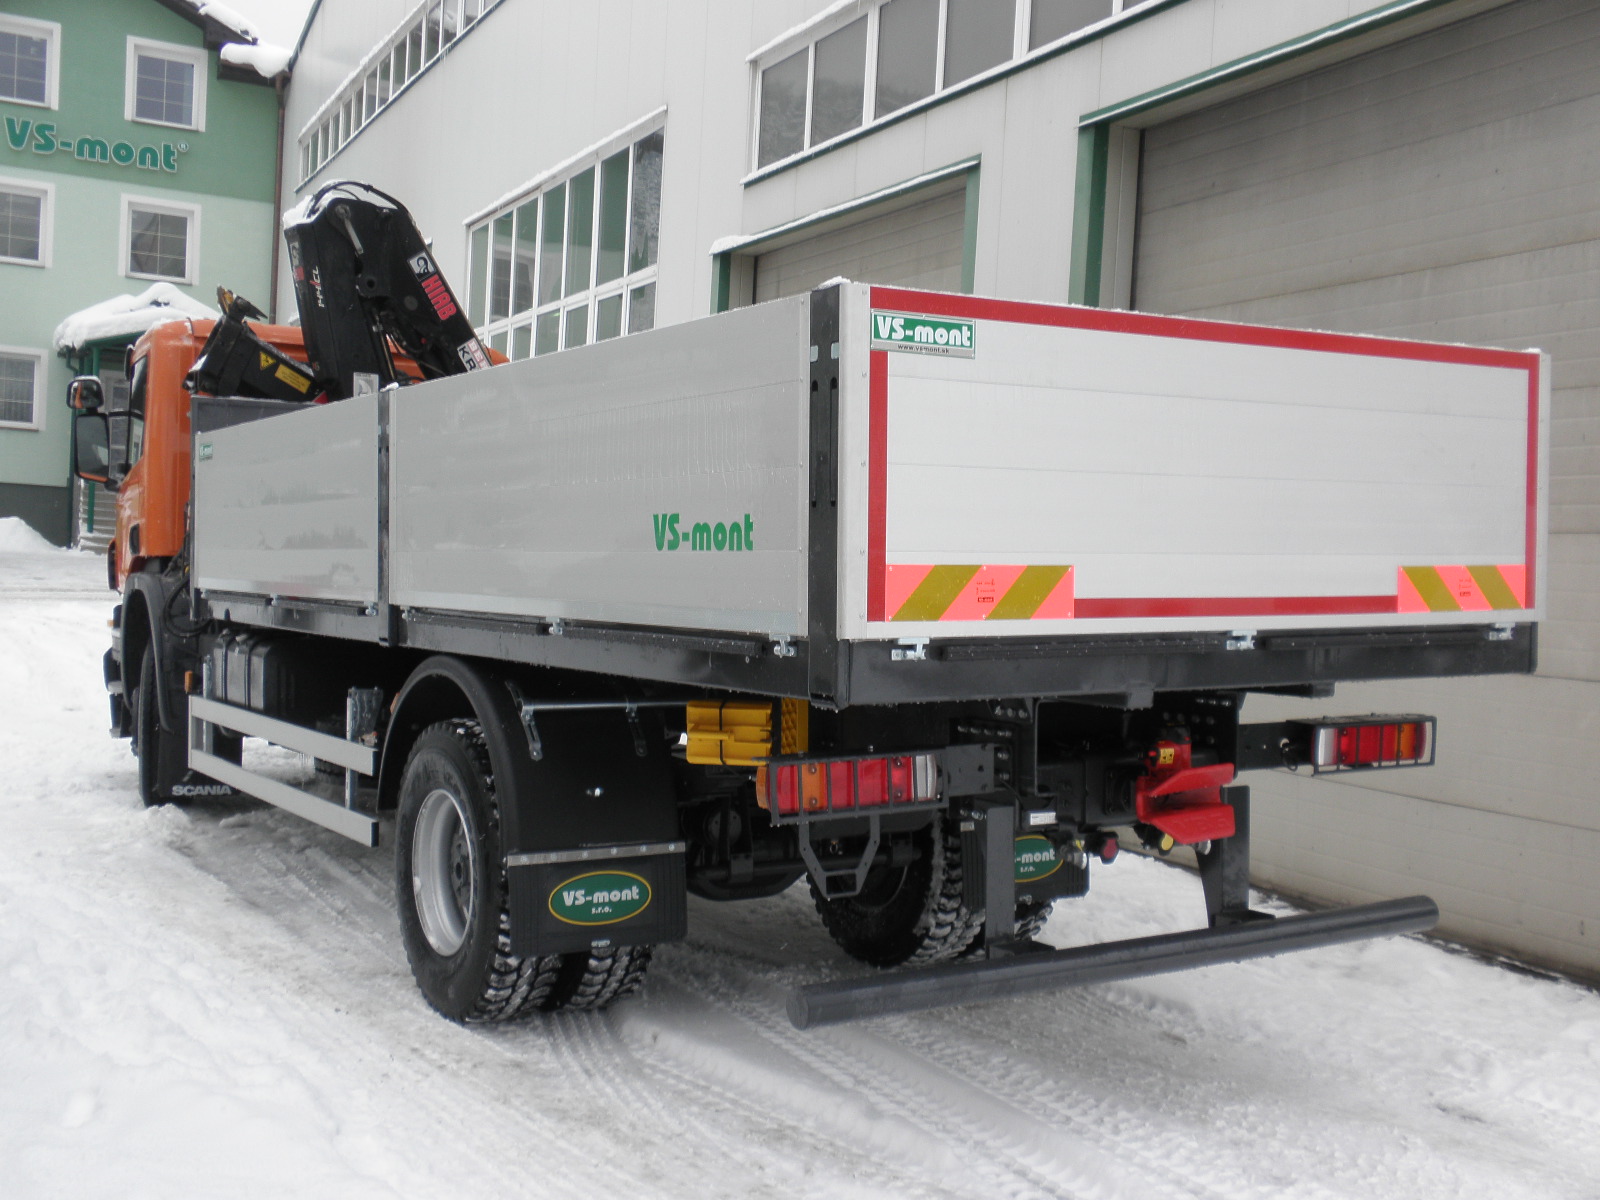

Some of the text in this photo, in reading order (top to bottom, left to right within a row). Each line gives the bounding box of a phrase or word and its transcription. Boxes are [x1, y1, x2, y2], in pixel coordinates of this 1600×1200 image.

[421, 274, 457, 321] HIAB
[876, 315, 971, 347] VS-mont
[652, 513, 754, 552] VS-mont
[171, 784, 232, 797] SCANIA
[562, 885, 640, 907] VS-mont
[591, 905, 612, 914] s.r.o.
